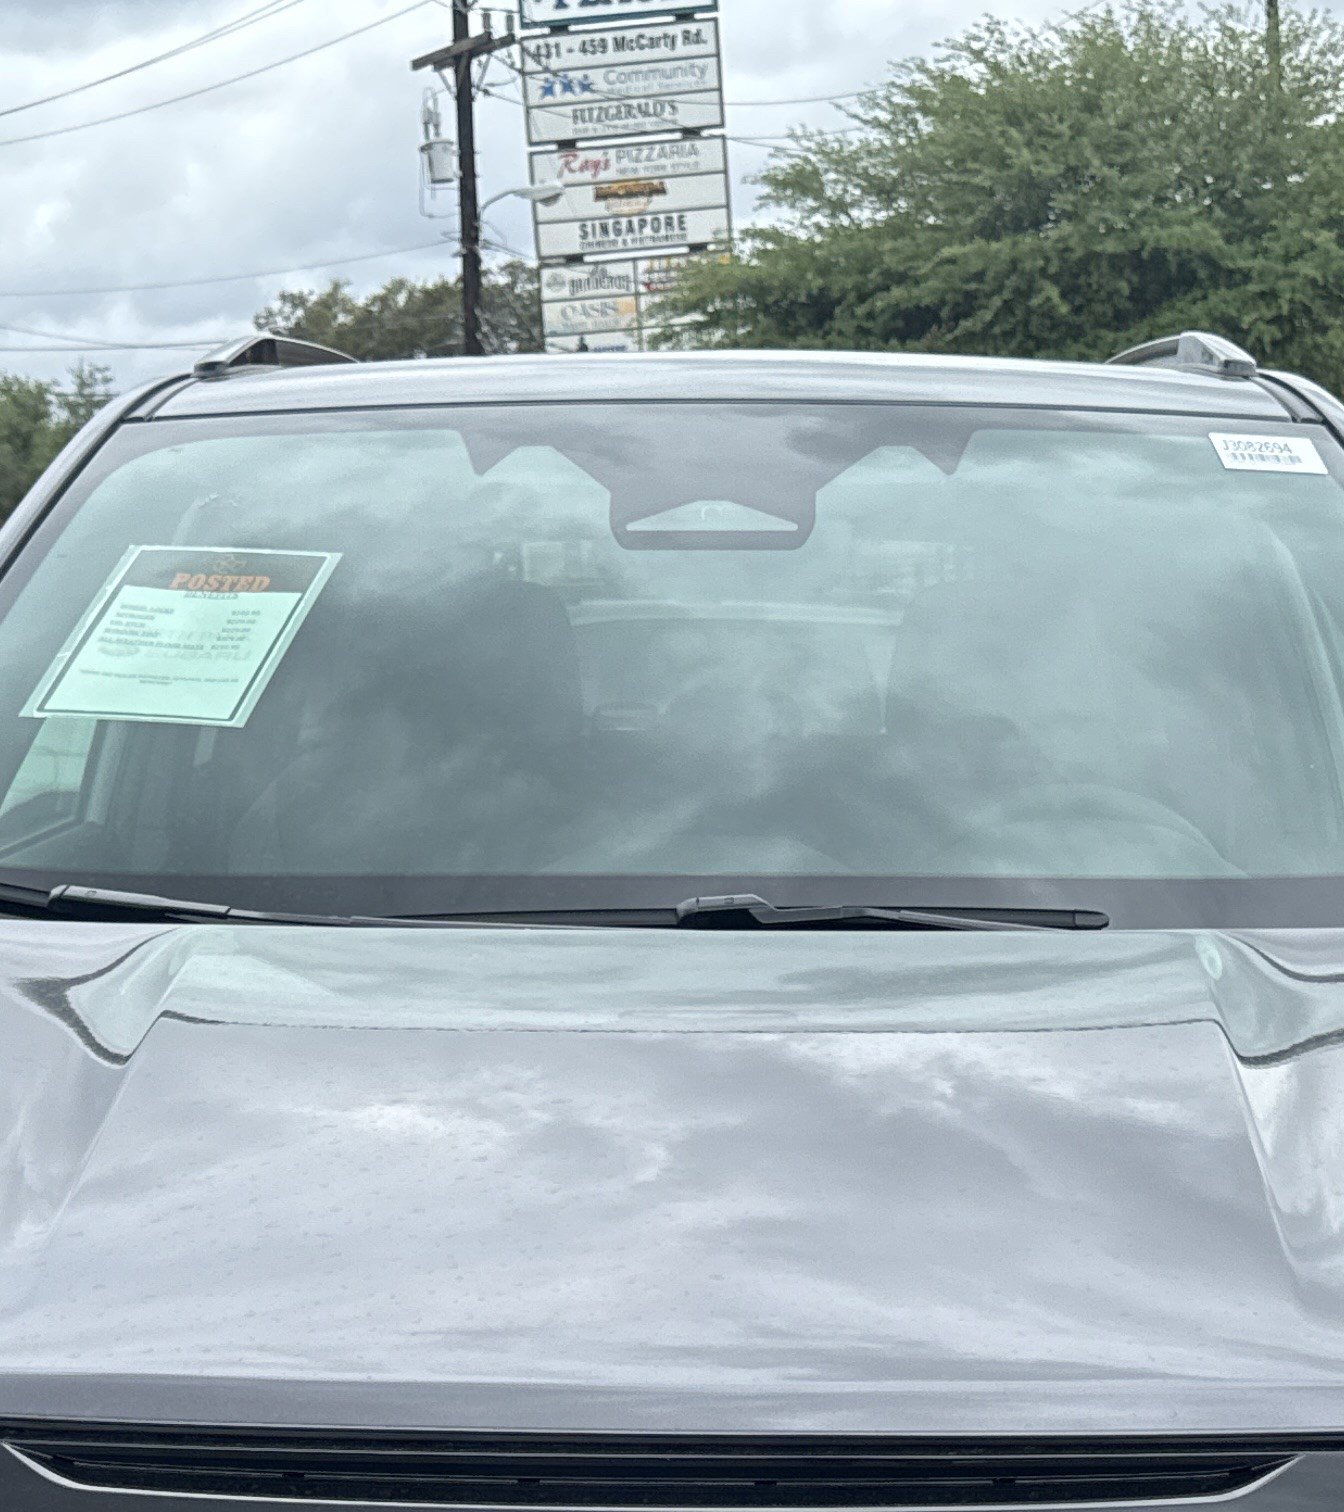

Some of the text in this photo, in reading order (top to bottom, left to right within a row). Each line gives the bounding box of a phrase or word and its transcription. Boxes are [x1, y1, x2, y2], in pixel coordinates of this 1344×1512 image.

[613, 33, 678, 52] McCarty
[681, 28, 709, 46] Rd.
[603, 62, 709, 86] Community
[579, 214, 687, 241] SINGAPORE
[169, 573, 271, 592] POSTED
